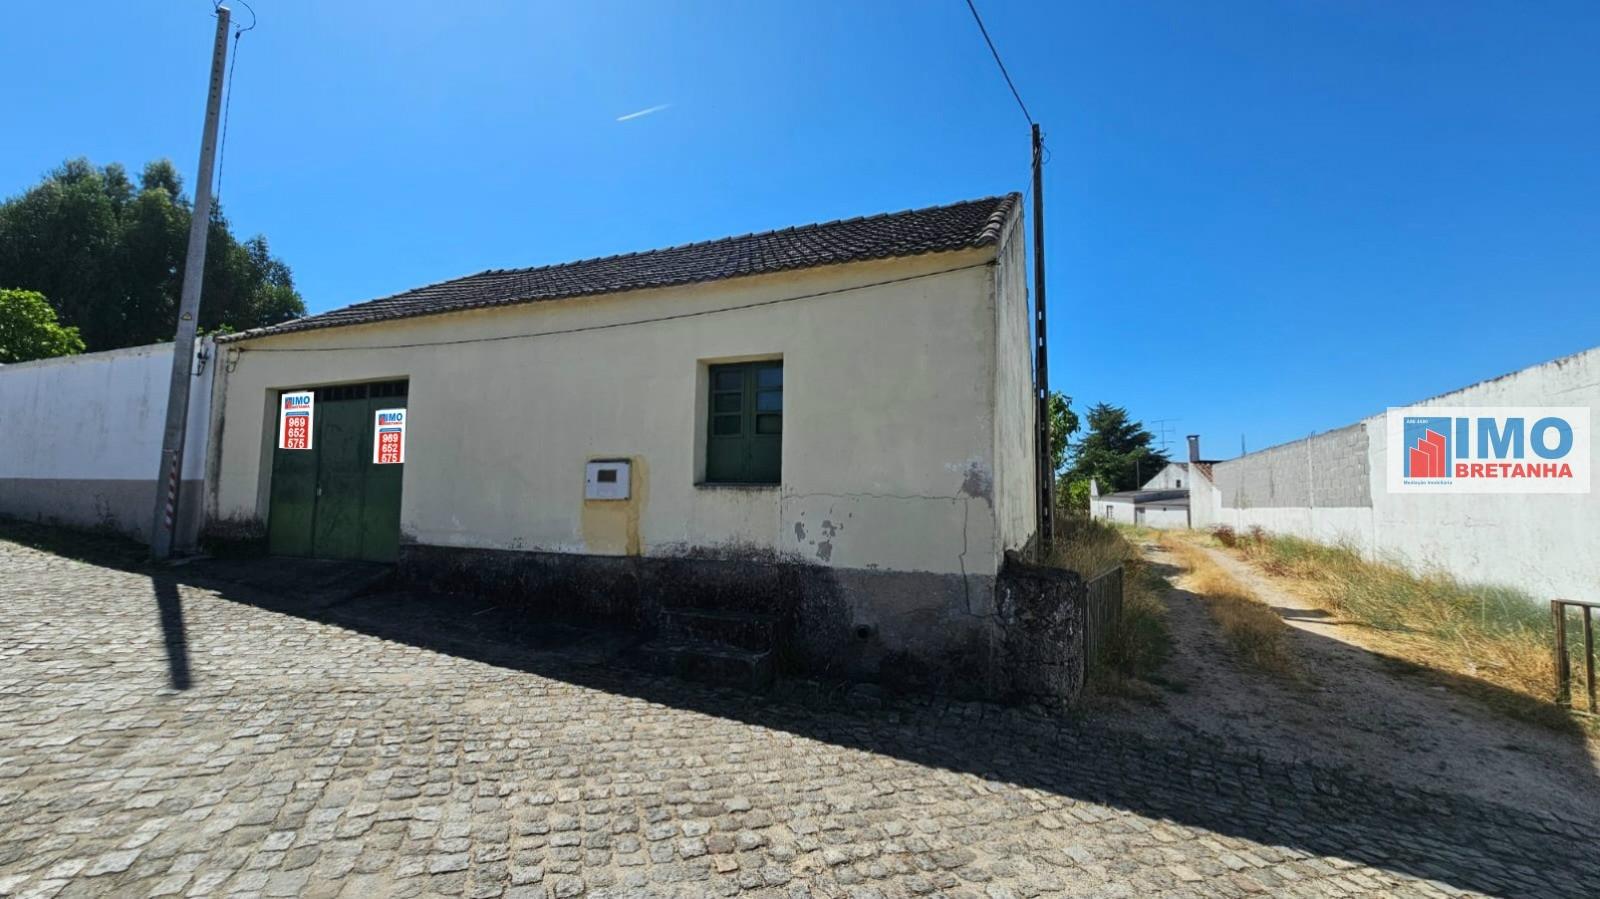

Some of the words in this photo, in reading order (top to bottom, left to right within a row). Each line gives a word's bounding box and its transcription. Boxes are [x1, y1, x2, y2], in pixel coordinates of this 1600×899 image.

[292, 396, 310, 405] IMO
[289, 417, 306, 427] 969
[385, 413, 403, 421] IMO
[288, 428, 305, 438] 652
[382, 433, 399, 443] 969
[288, 438, 305, 448] 575
[382, 443, 398, 453] 652
[381, 453, 398, 463] 575
